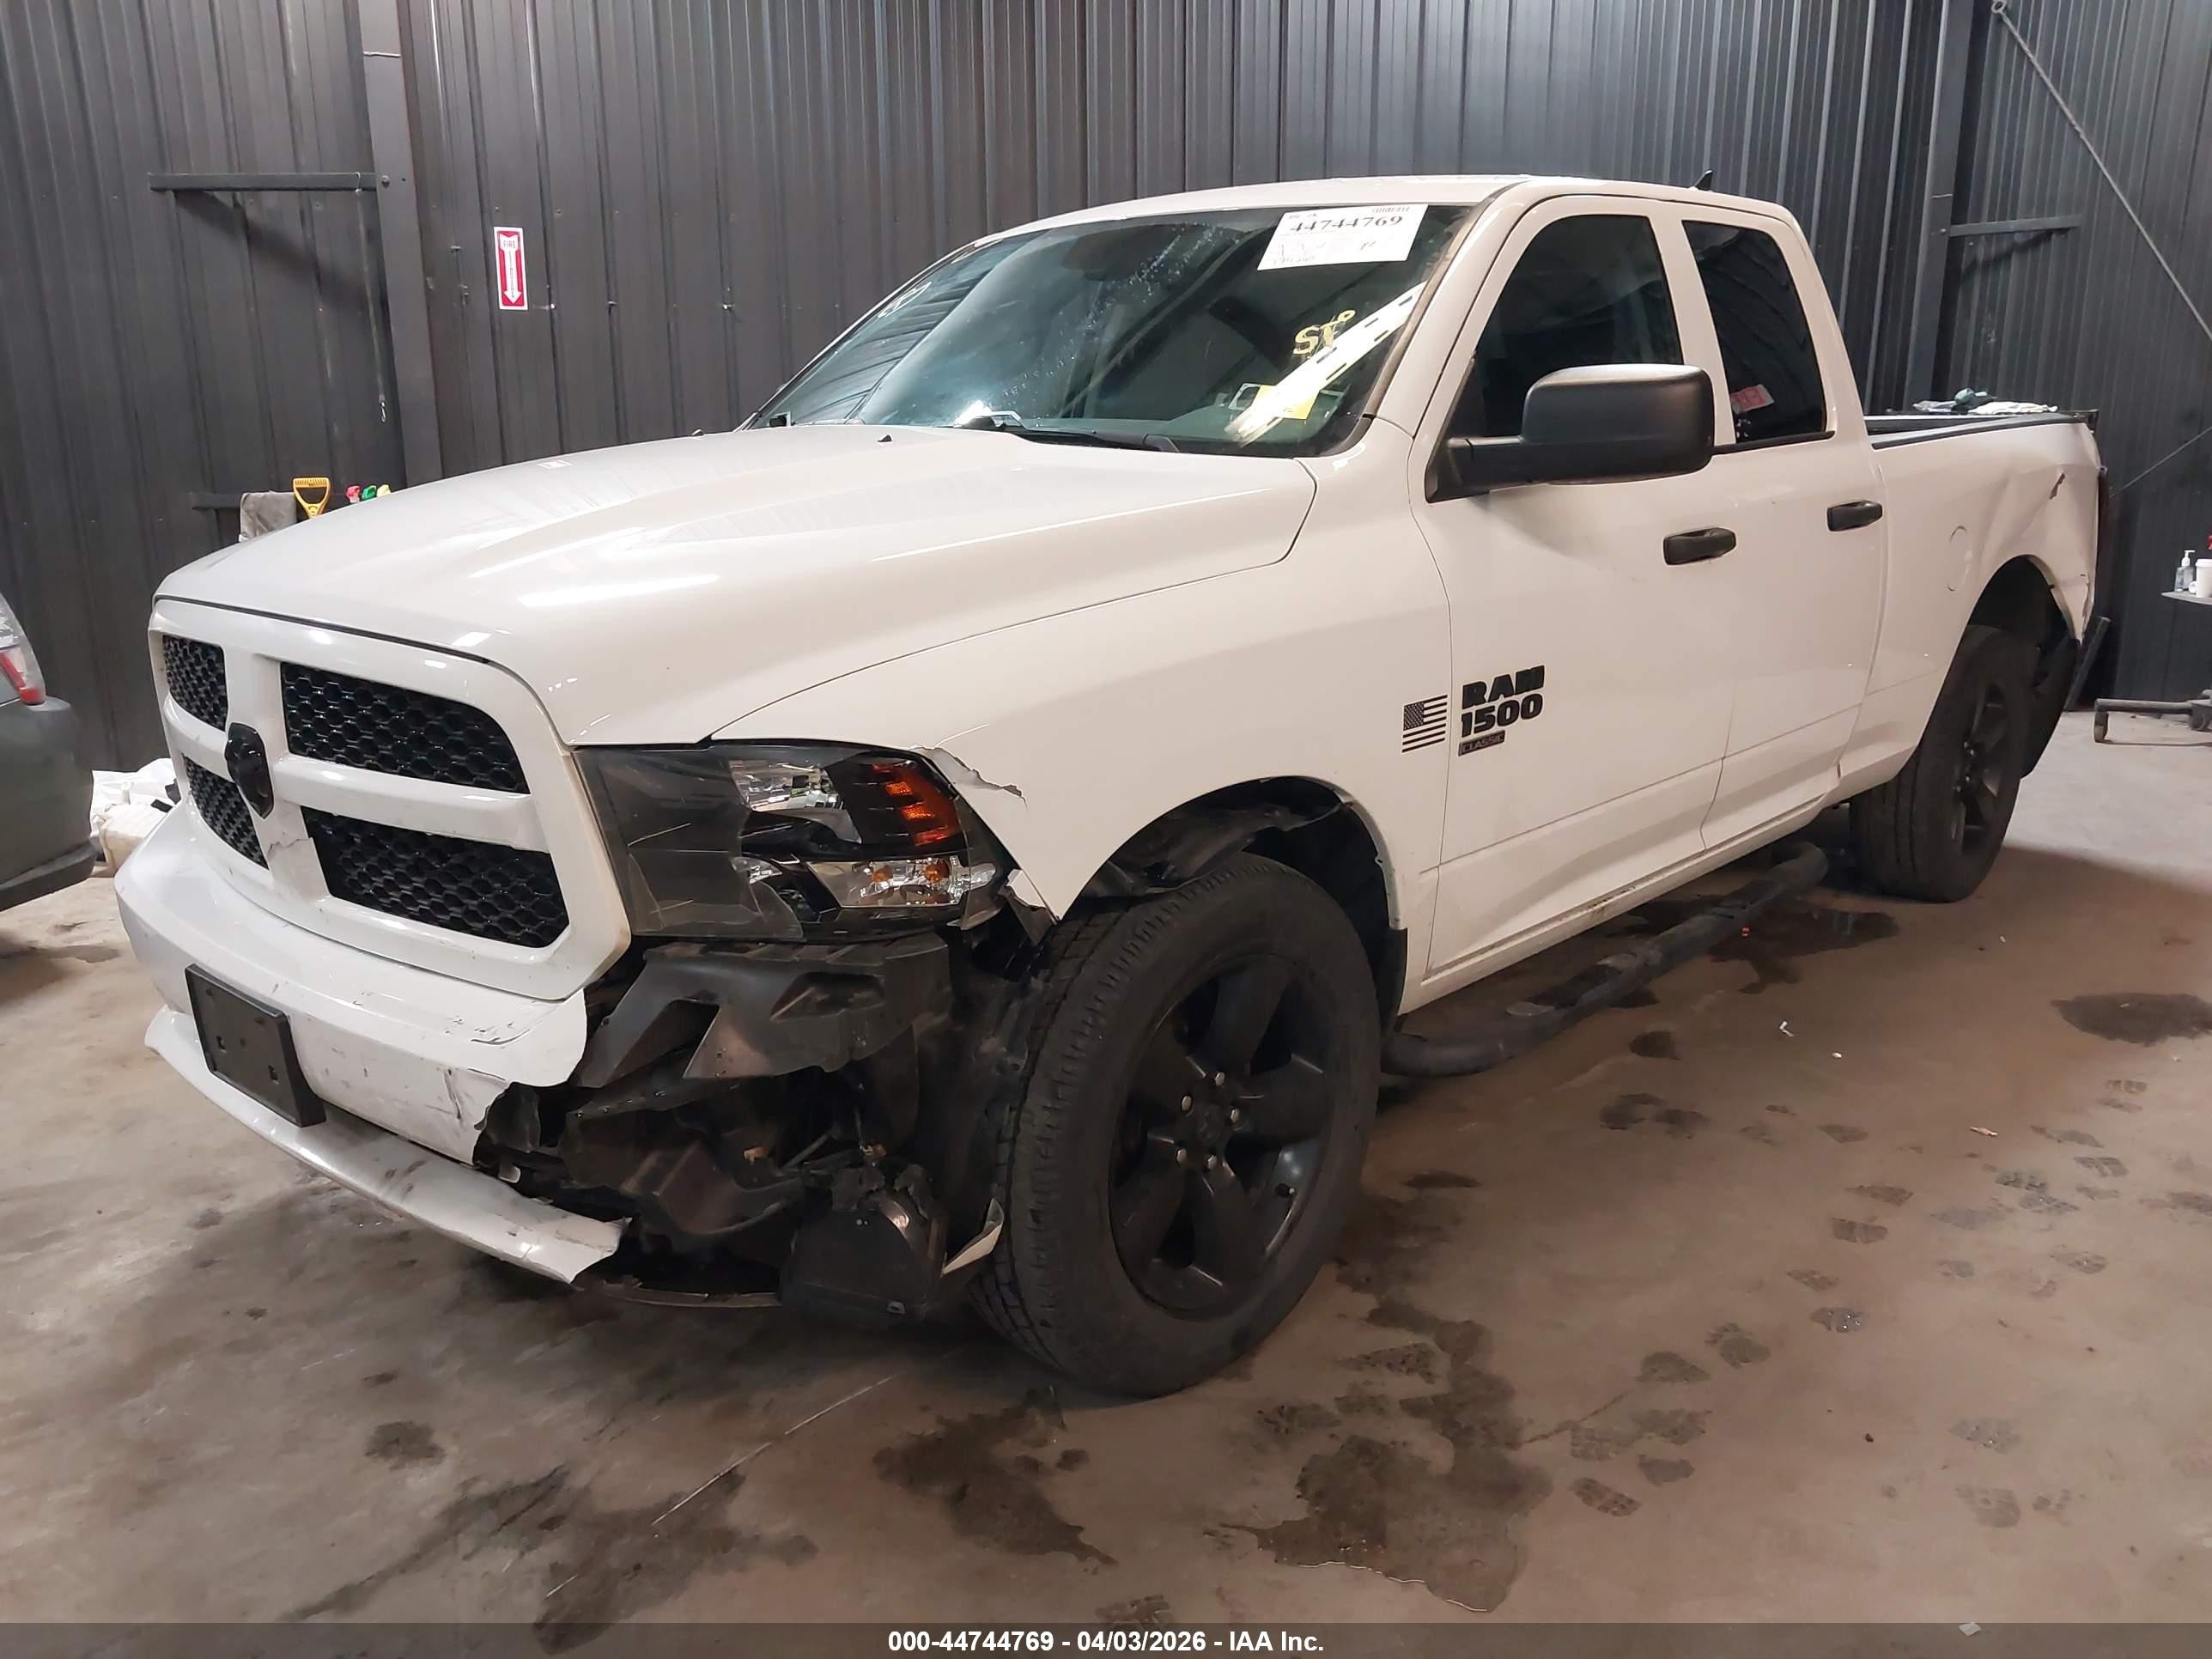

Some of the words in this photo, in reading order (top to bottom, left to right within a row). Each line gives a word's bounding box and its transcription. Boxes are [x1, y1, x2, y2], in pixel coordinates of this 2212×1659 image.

[1290, 215, 1403, 233] 44744769
[503, 240, 516, 249] FIRE
[1462, 665, 1545, 710] RAM
[1461, 693, 1543, 738] 1500
